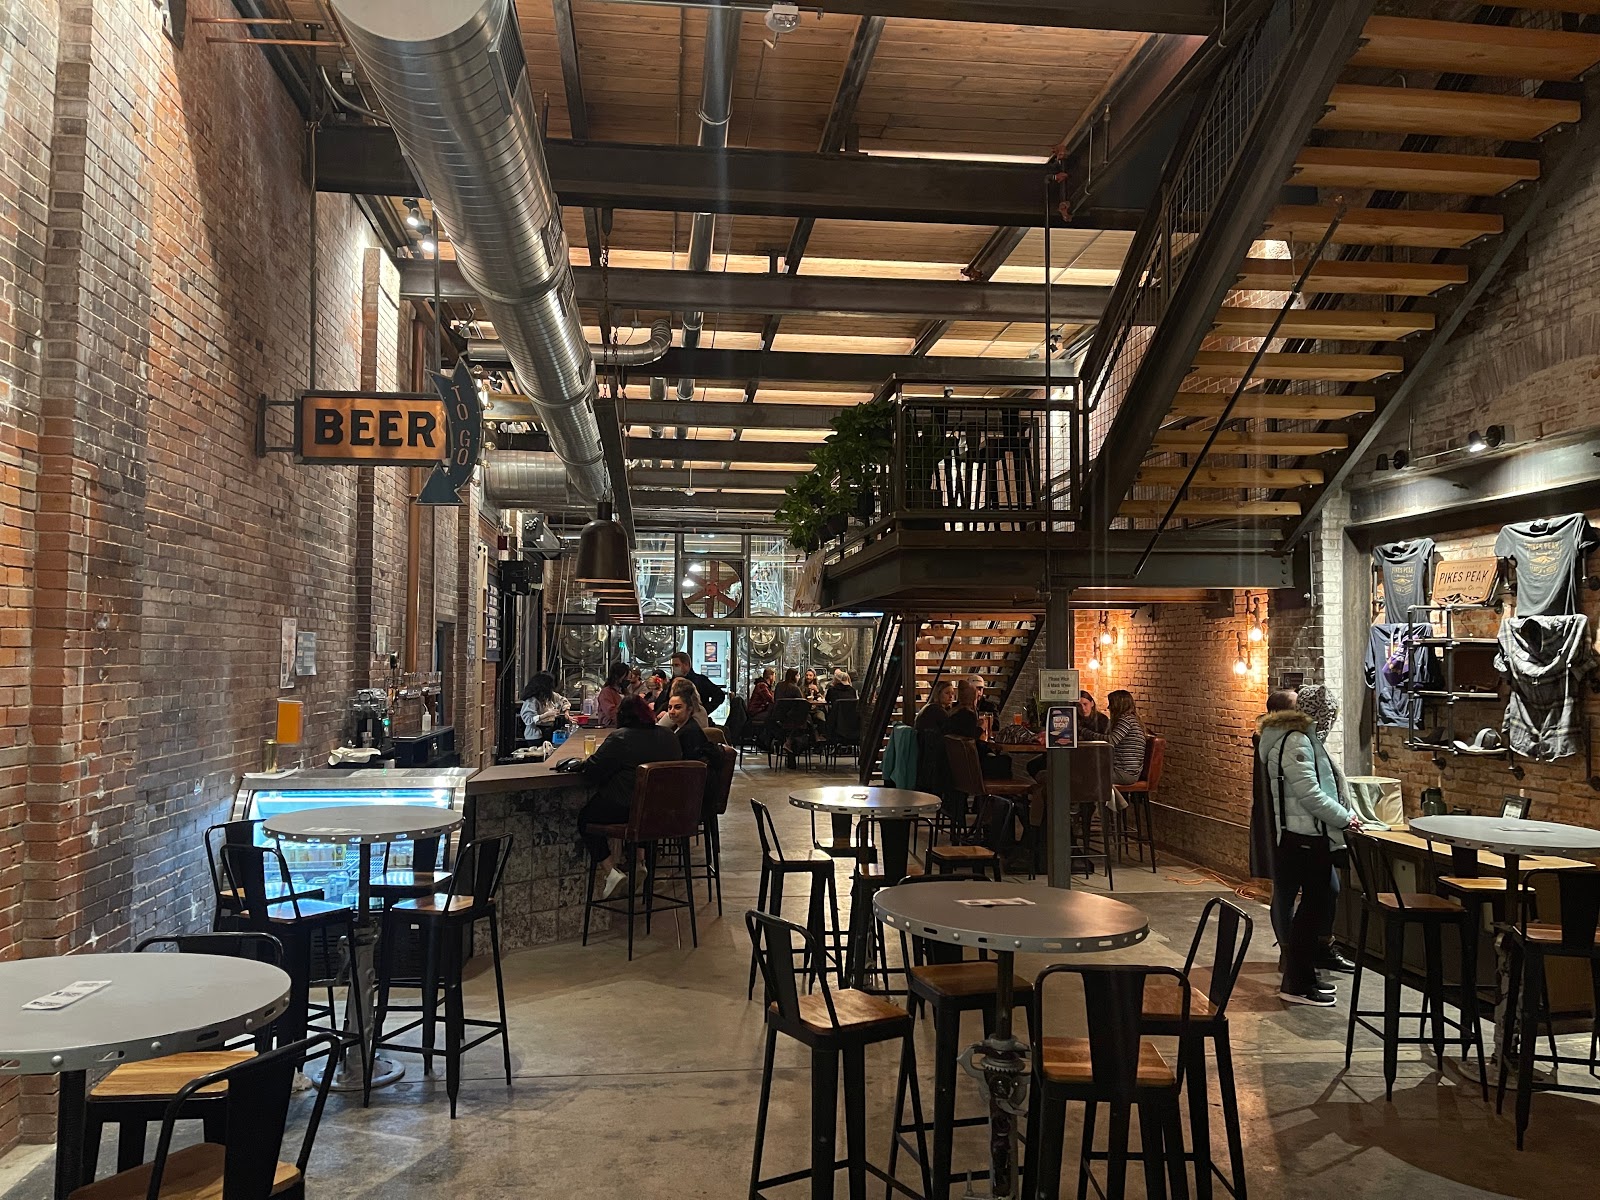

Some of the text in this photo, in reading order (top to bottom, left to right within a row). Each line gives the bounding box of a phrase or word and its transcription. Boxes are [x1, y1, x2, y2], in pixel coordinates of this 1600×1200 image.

[315, 408, 436, 447] BEER
[451, 385, 471, 466] TO GO
[1438, 569, 1490, 585] PIKES PEAK
